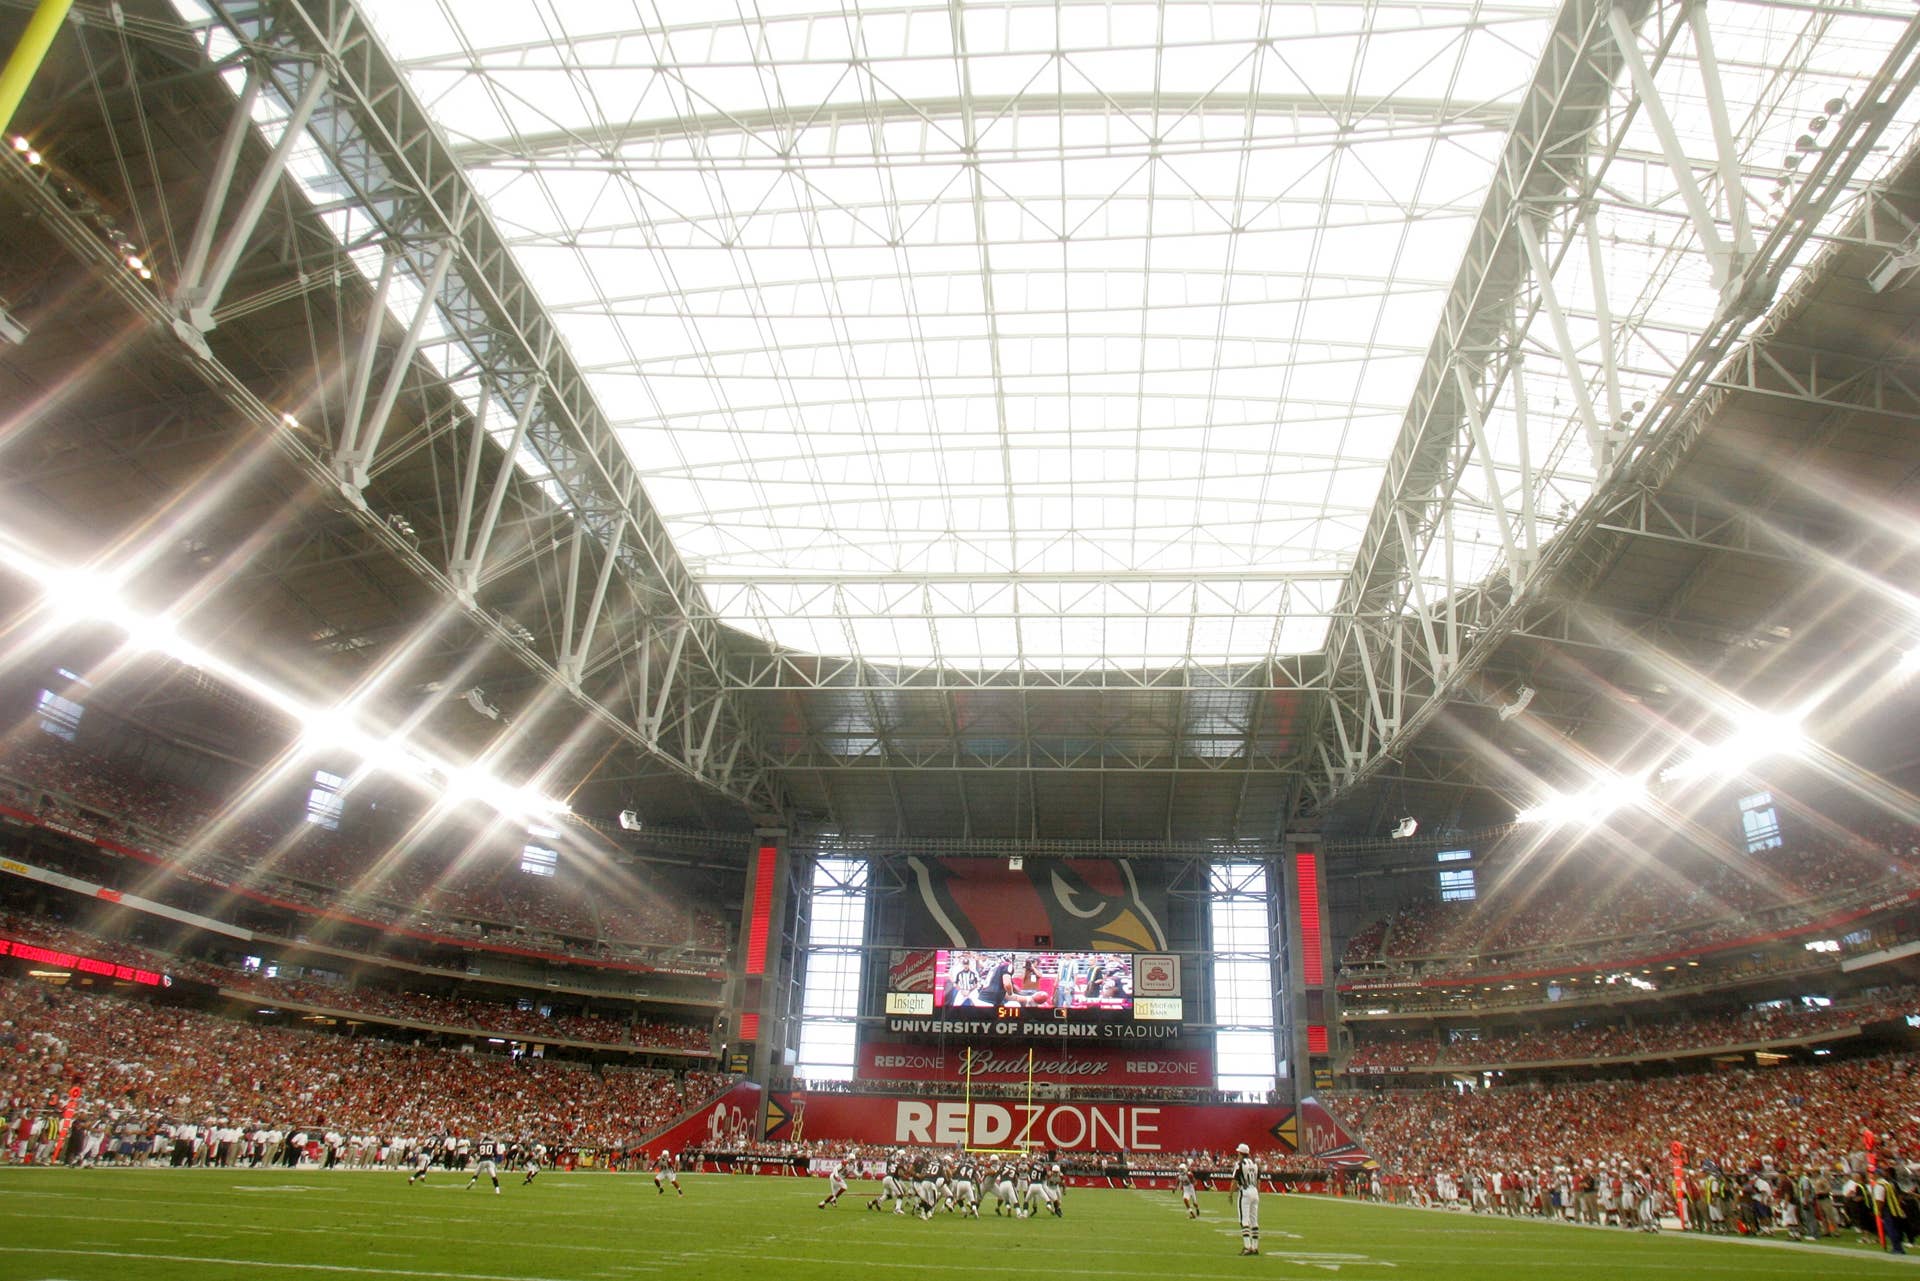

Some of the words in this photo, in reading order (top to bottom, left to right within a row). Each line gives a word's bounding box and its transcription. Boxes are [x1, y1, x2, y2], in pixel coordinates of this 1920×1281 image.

[11, 942, 80, 969] TECHNOLOGY
[77, 957, 116, 977] BEHIND
[115, 965, 136, 981] THE
[134, 969, 161, 986] TEAM
[893, 993, 925, 1012] Insight
[890, 1019, 992, 1034] UNIVERSITY
[995, 1023, 1018, 1035] OF
[1023, 1022, 1098, 1037] PHOENIX
[1104, 1024, 1179, 1038] STADIUM
[874, 1055, 945, 1069] REDZONE
[958, 1048, 1109, 1076] Budweiser
[1126, 1061, 1198, 1074] REDZONE
[895, 1100, 1162, 1150] REDZONE
[479, 1144, 494, 1155] 80
[959, 1166, 974, 1179] 44
[1001, 1166, 1016, 1178] 73
[1031, 1169, 1042, 1180] 81
